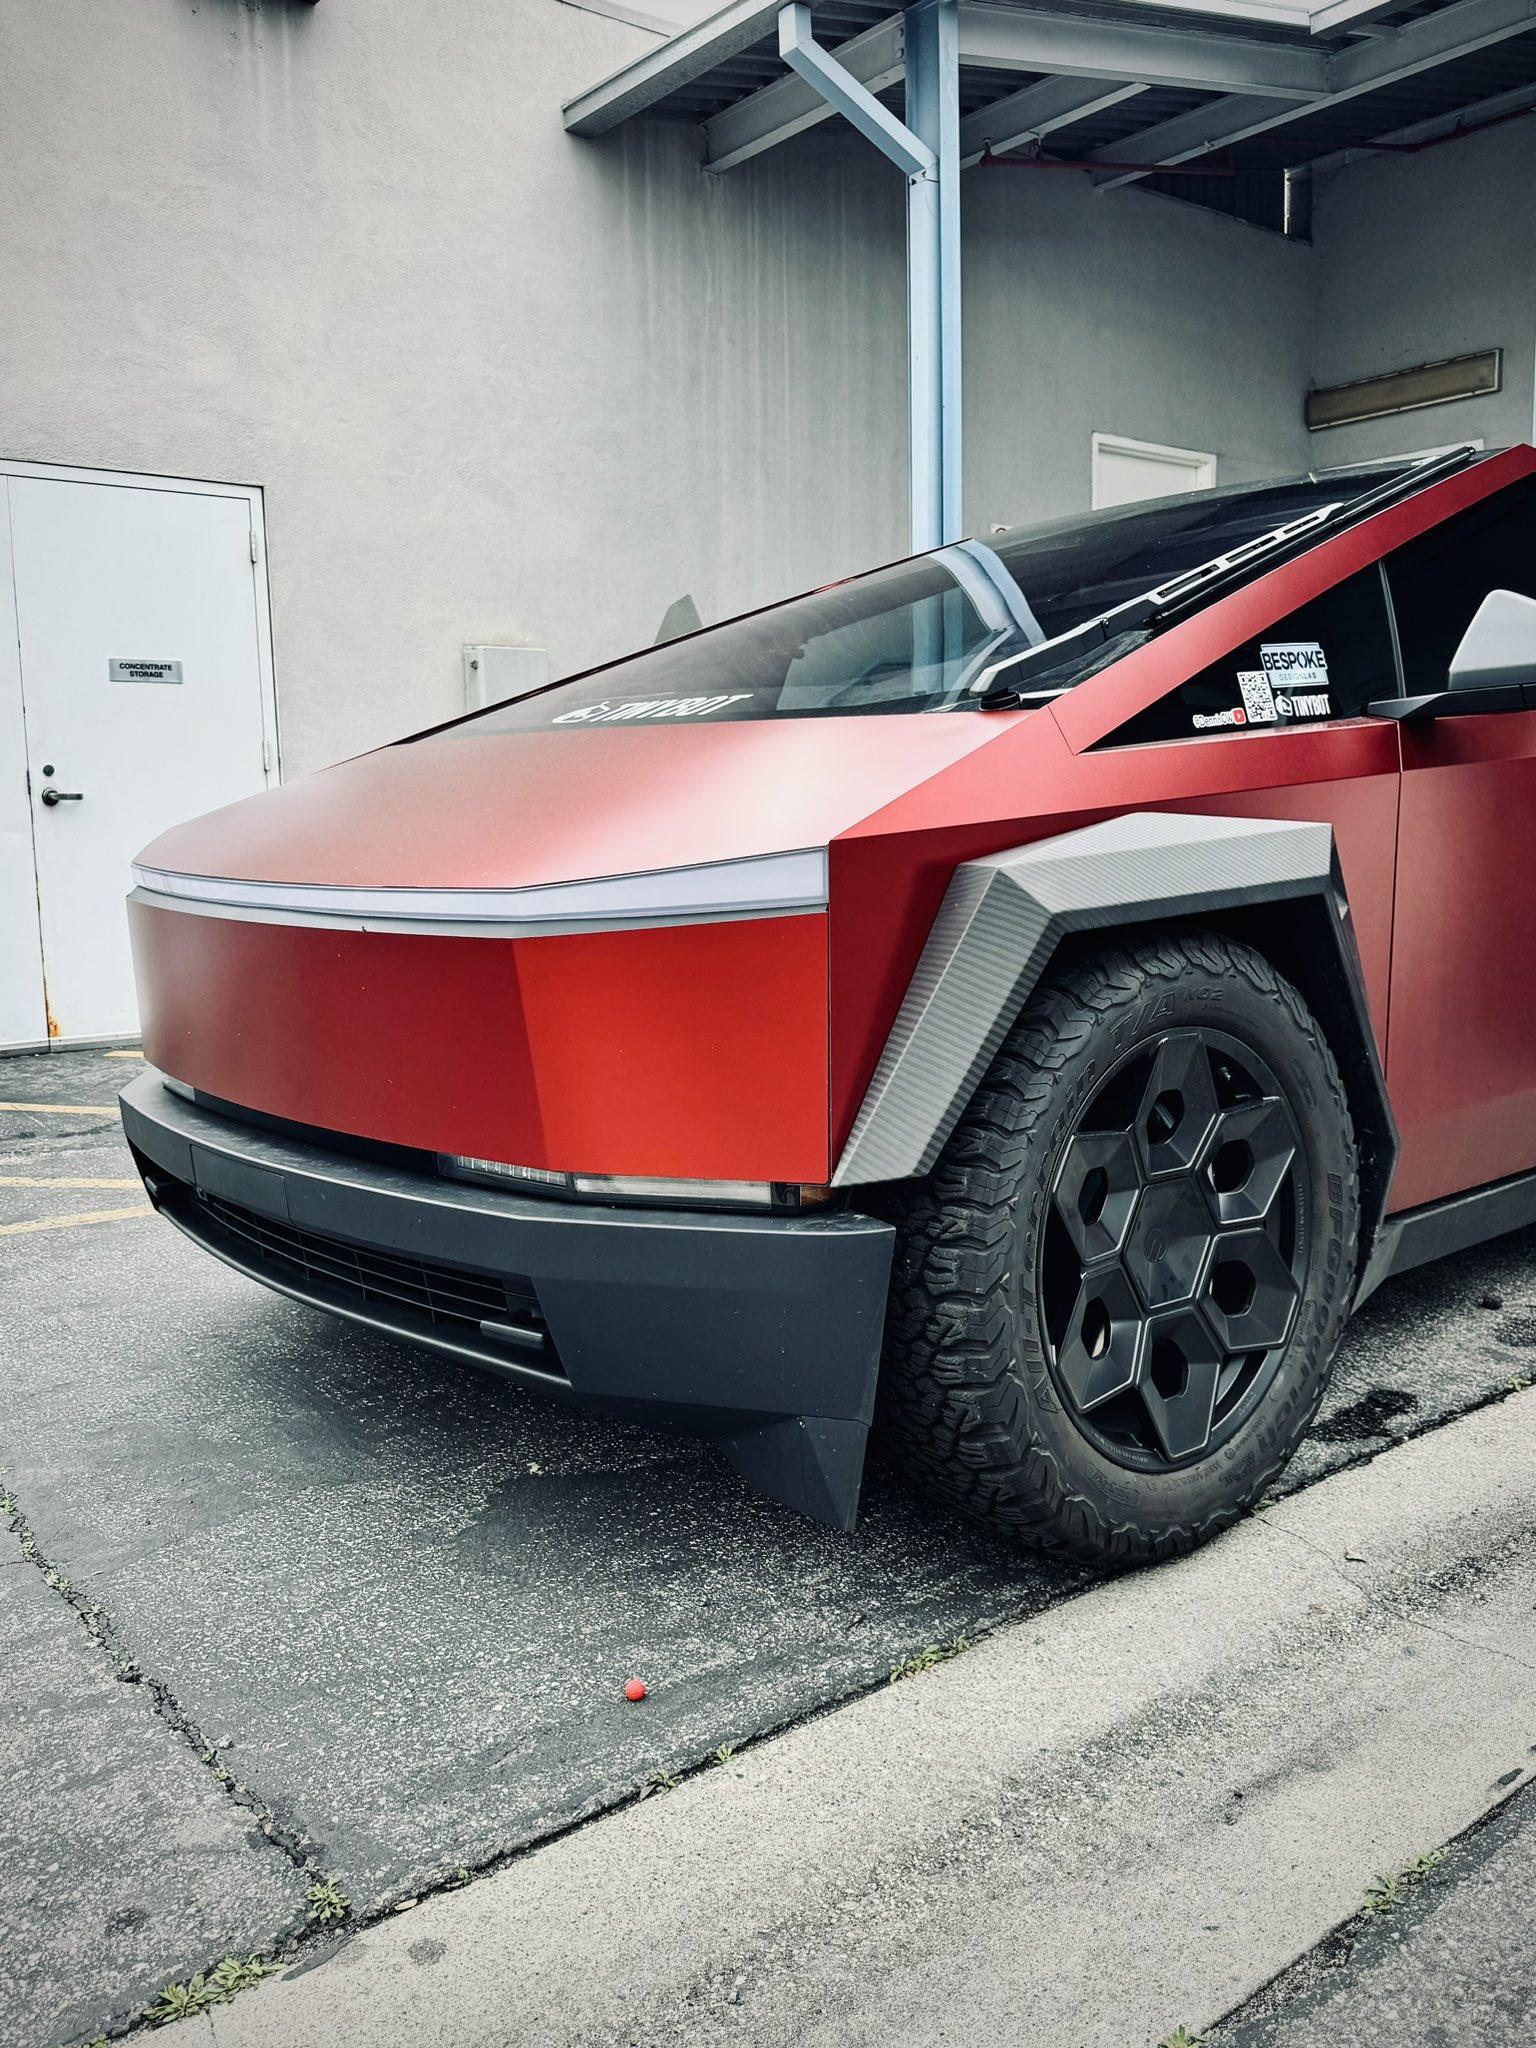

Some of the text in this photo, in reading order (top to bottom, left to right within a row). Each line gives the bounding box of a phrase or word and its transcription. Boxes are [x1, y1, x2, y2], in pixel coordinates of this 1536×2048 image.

[119, 663, 173, 671] CONCENTRATE
[1261, 650, 1326, 671] BESPOKE
[1290, 694, 1331, 717] TINYBOT
